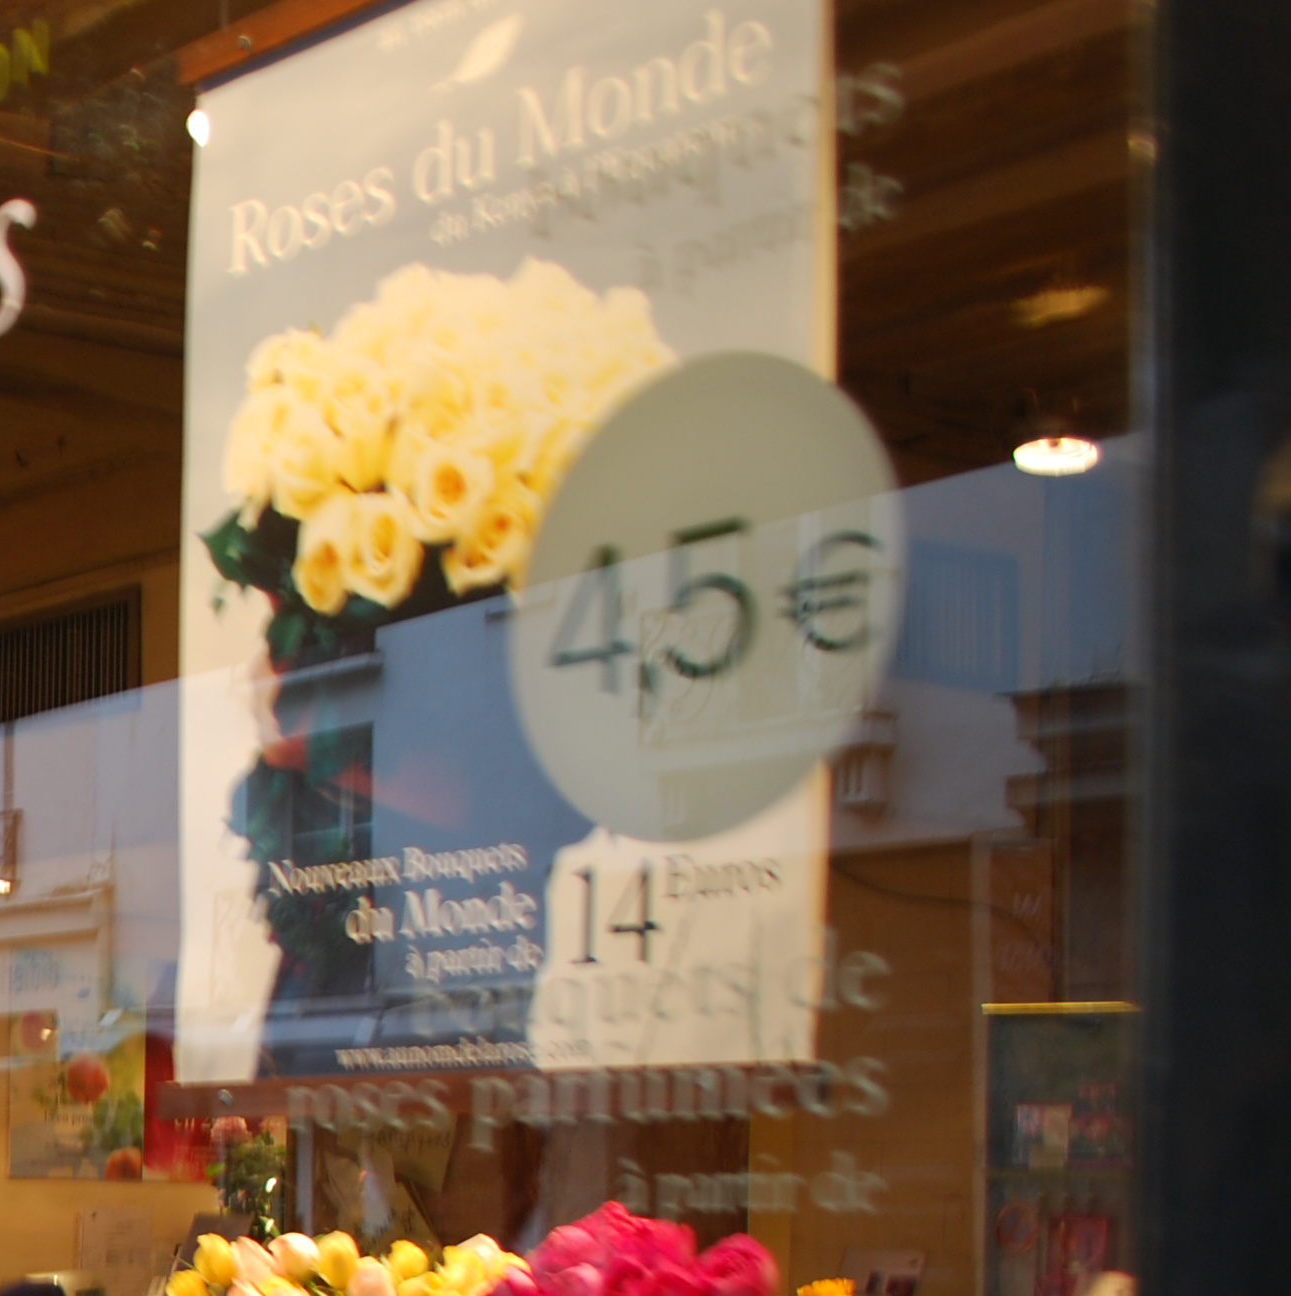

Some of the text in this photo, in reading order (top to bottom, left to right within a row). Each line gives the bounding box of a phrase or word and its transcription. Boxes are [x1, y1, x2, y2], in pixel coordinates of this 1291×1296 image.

[225, 169, 397, 276] Roses
[411, 118, 495, 203] du
[514, 8, 774, 172] Monde
[779, 528, 881, 655] €
[344, 880, 539, 946] du Monde
[569, 862, 664, 965] 14
[285, 1070, 455, 1138] roses
